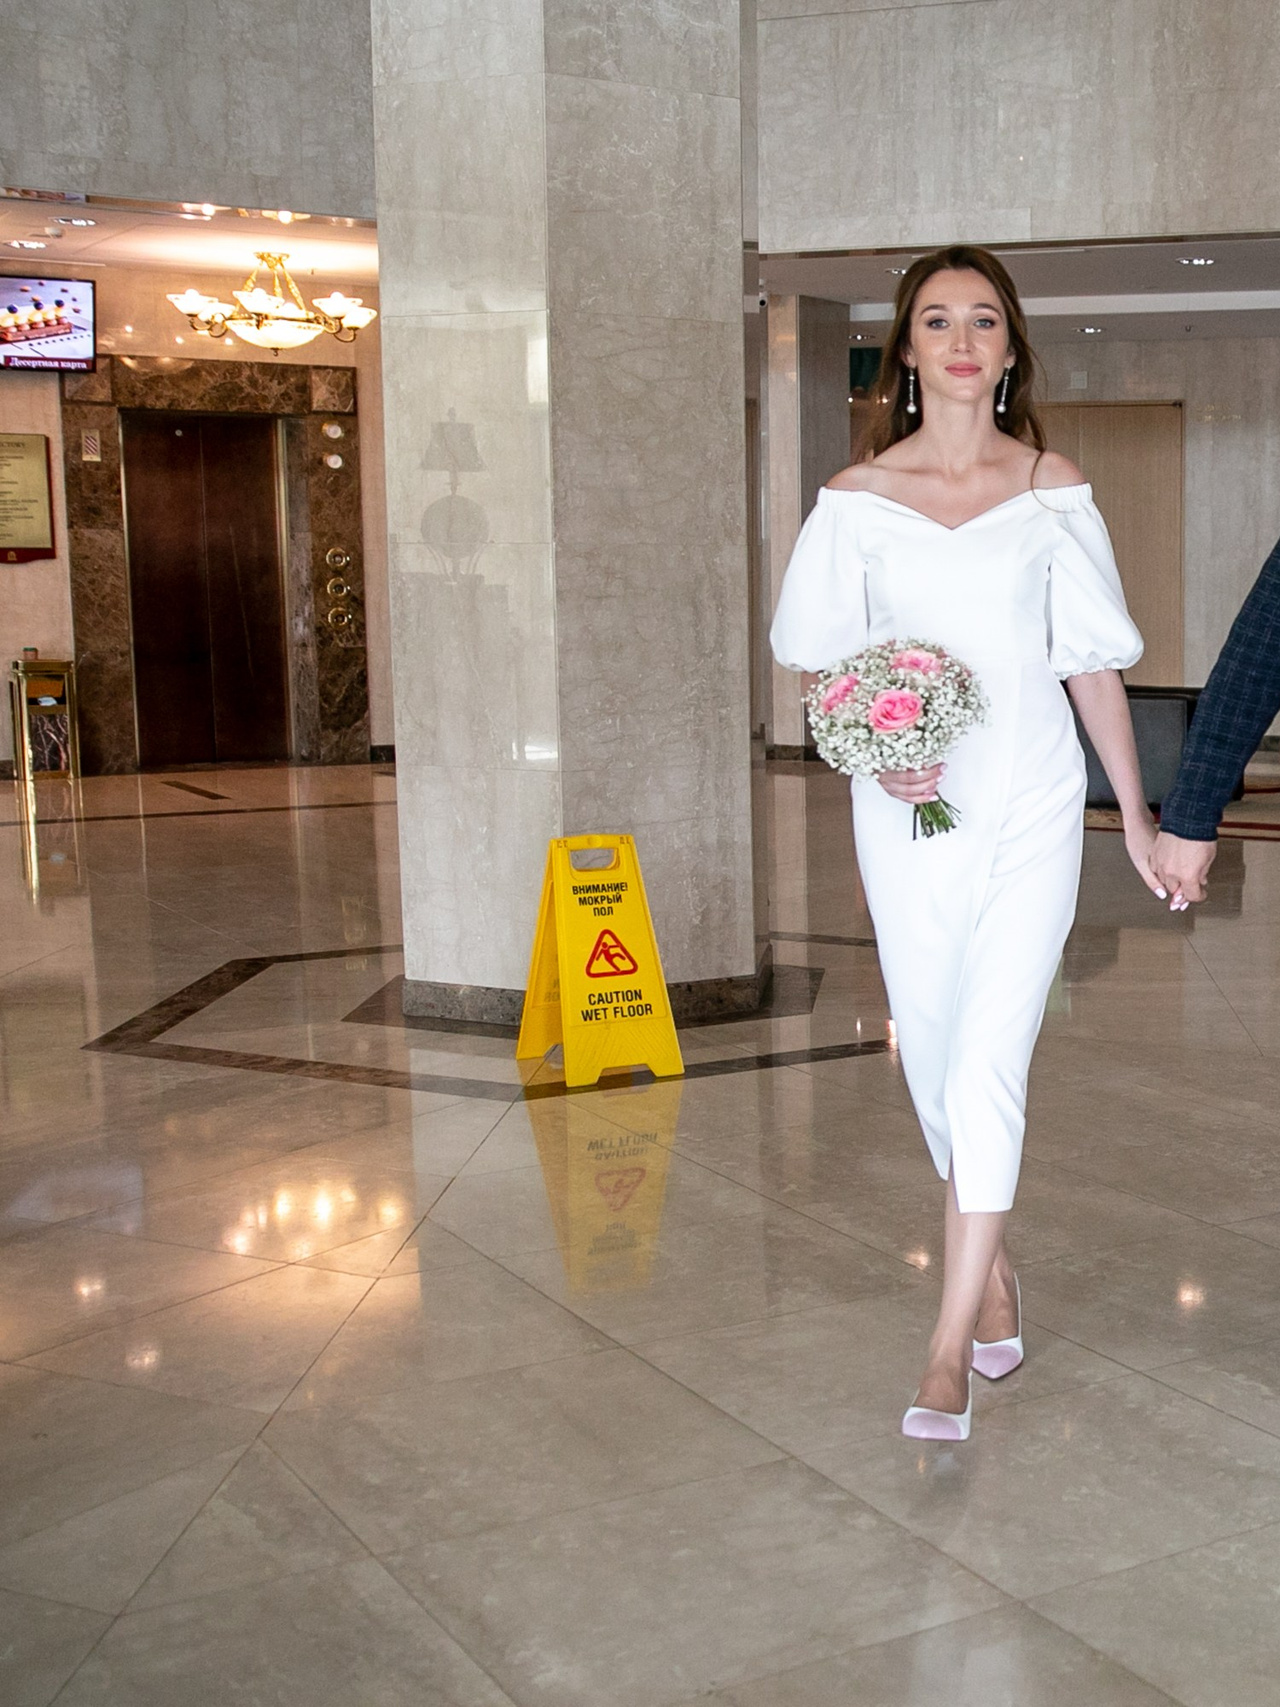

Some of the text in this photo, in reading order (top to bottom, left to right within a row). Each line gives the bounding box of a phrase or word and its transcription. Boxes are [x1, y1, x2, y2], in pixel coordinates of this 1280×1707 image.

[9, 357, 87, 369] Десертная карта
[572, 882, 628, 895] ВНИМАНИЕ!
[578, 892, 623, 906] МОКРЫЙ
[593, 905, 614, 917] ПОЛ
[588, 989, 643, 1006] CAUTION
[581, 1003, 653, 1022] WET FLOOR
